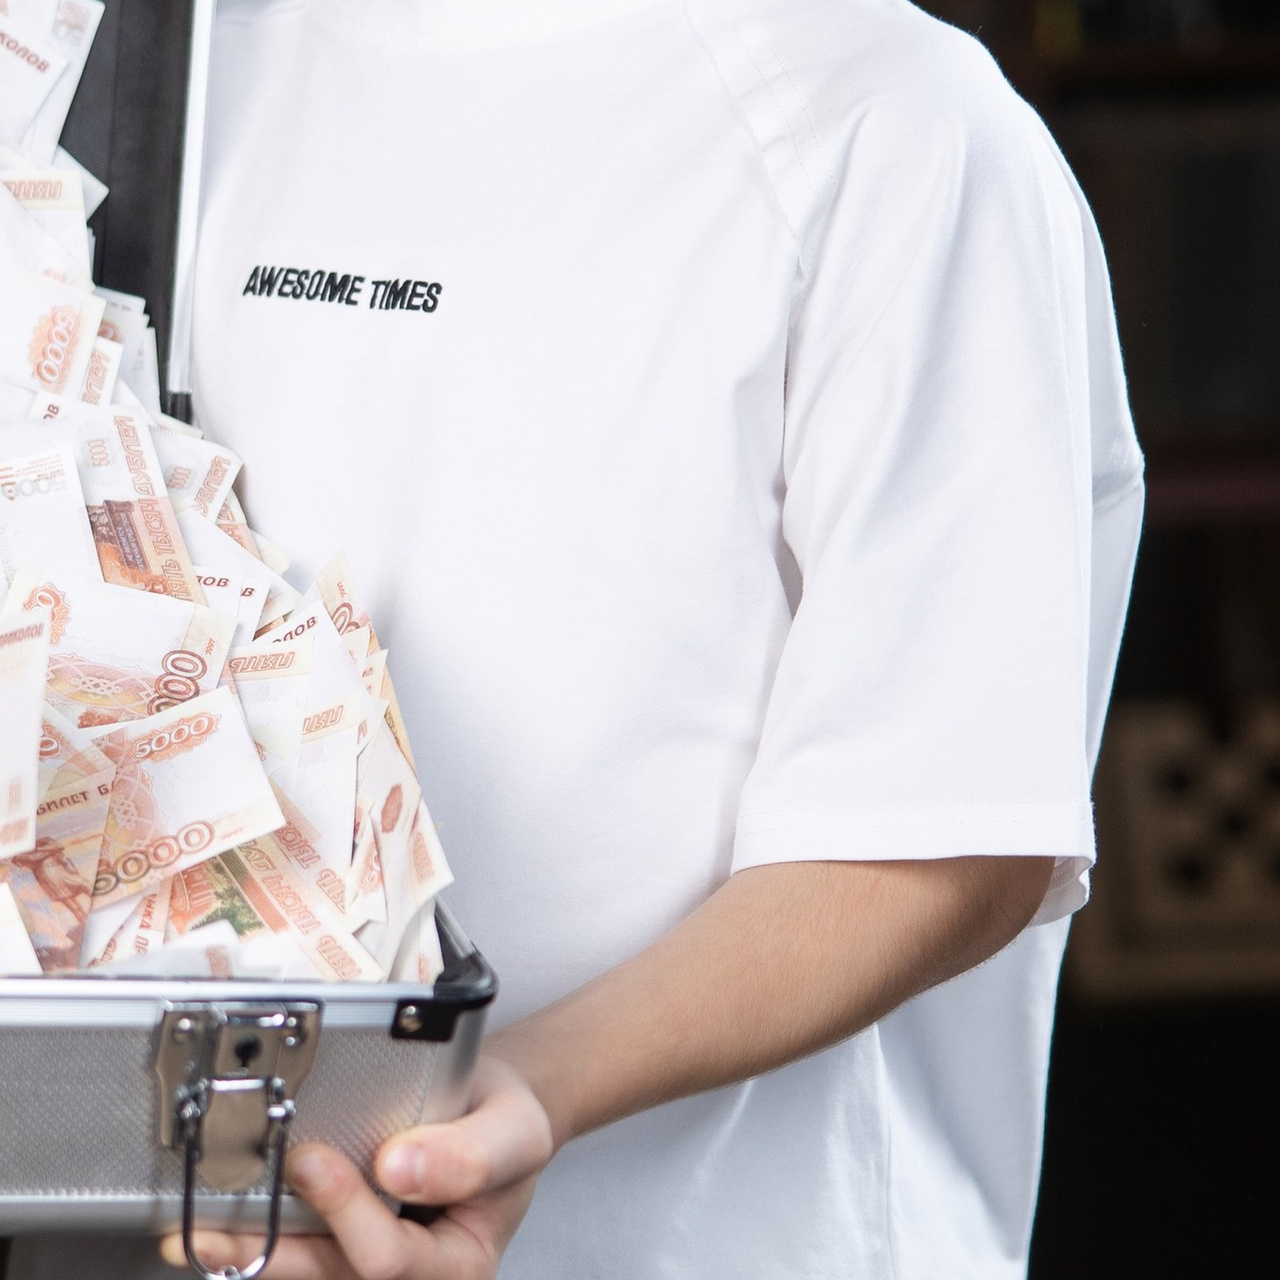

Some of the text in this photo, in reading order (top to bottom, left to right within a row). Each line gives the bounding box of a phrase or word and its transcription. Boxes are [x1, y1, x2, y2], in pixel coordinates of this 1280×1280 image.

[242, 265, 442, 313] AWESOME TIMES
[39, 309, 76, 382] 5000
[114, 415, 154, 497] ДУБЛЕЙ
[193, 455, 230, 516] УБЛЕЙ
[139, 499, 173, 557] ТЫСЯЧ
[229, 652, 295, 673] ПЯТЬ
[136, 714, 213, 758] 5000
[36, 789, 89, 815] БИЛЕТ
[94, 821, 215, 894] 5000
